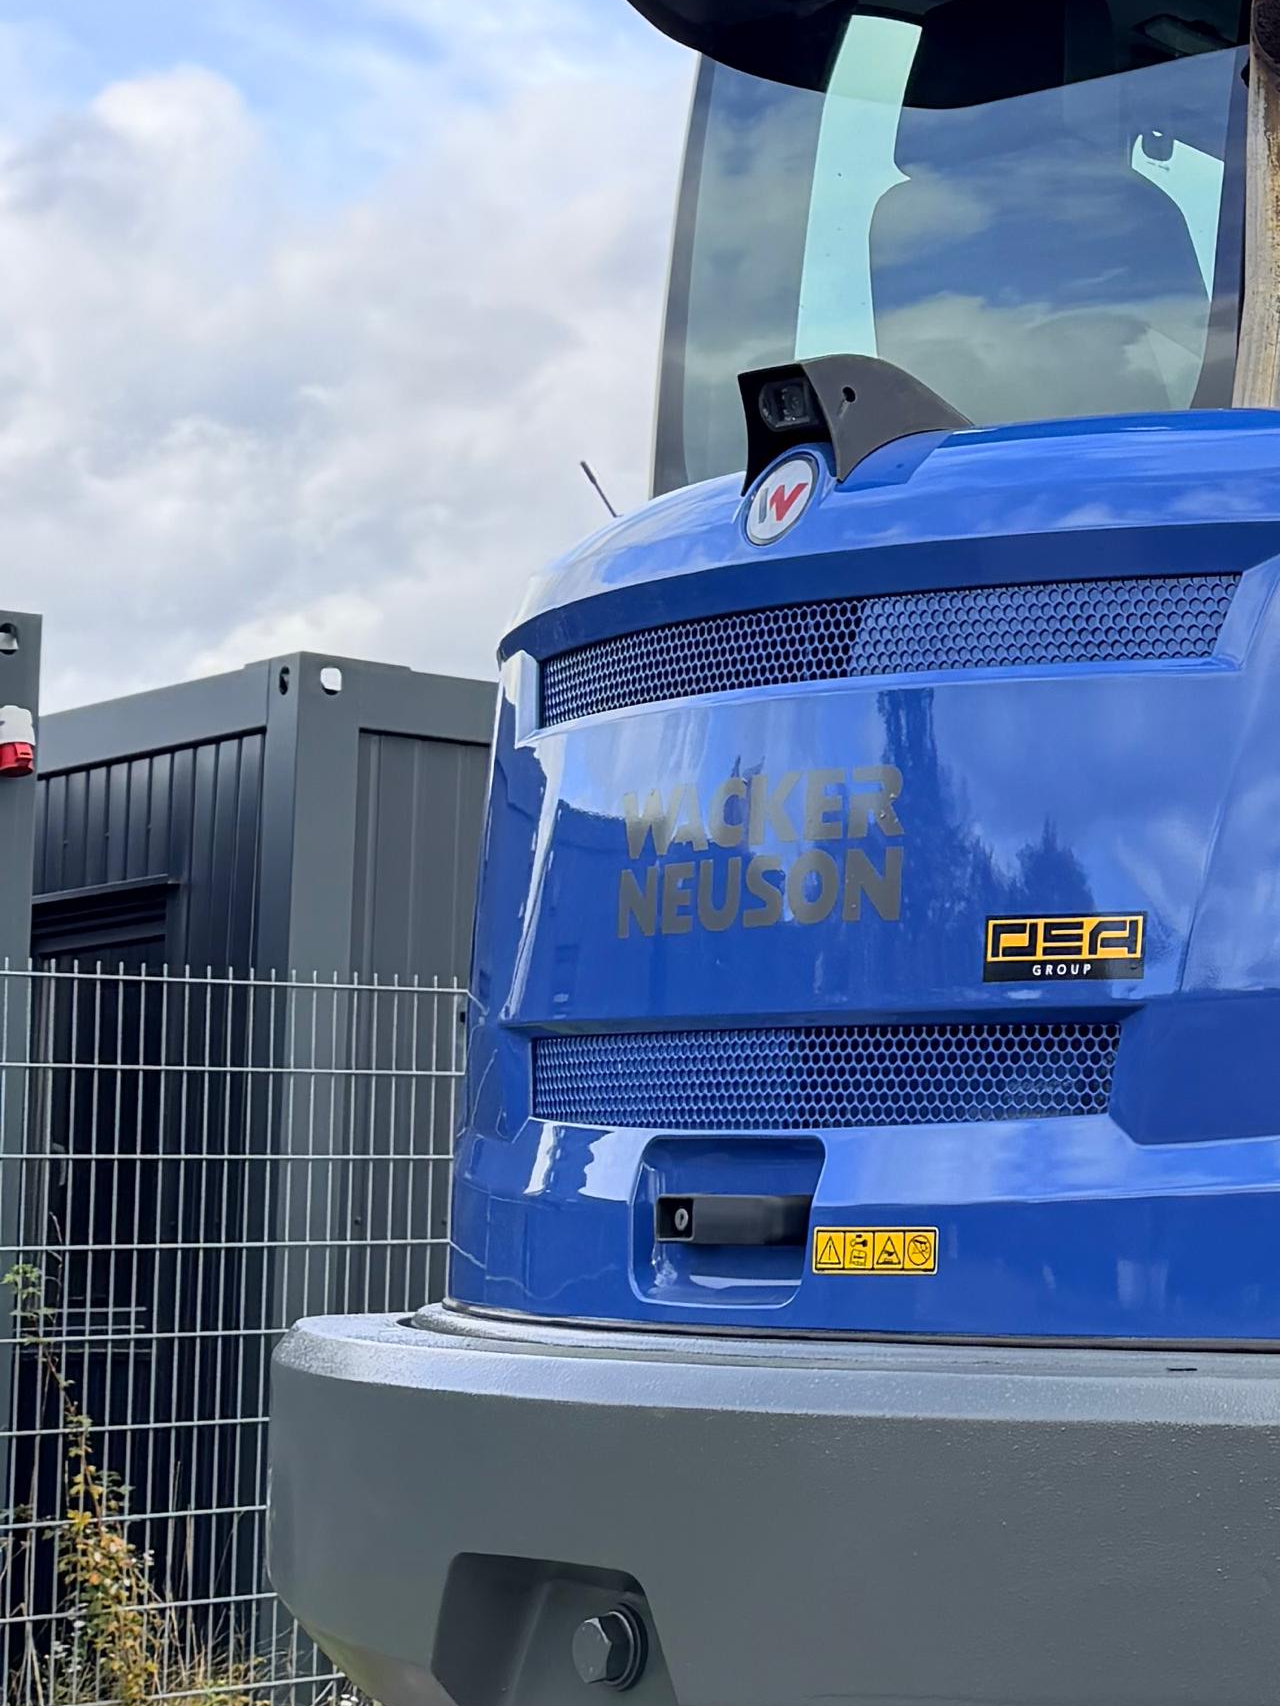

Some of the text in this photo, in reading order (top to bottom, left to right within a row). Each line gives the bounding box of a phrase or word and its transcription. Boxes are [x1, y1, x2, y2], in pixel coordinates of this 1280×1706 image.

[624, 764, 905, 860] WACKER
[618, 846, 905, 939] NEUSON
[1032, 963, 1092, 976] GROUP
